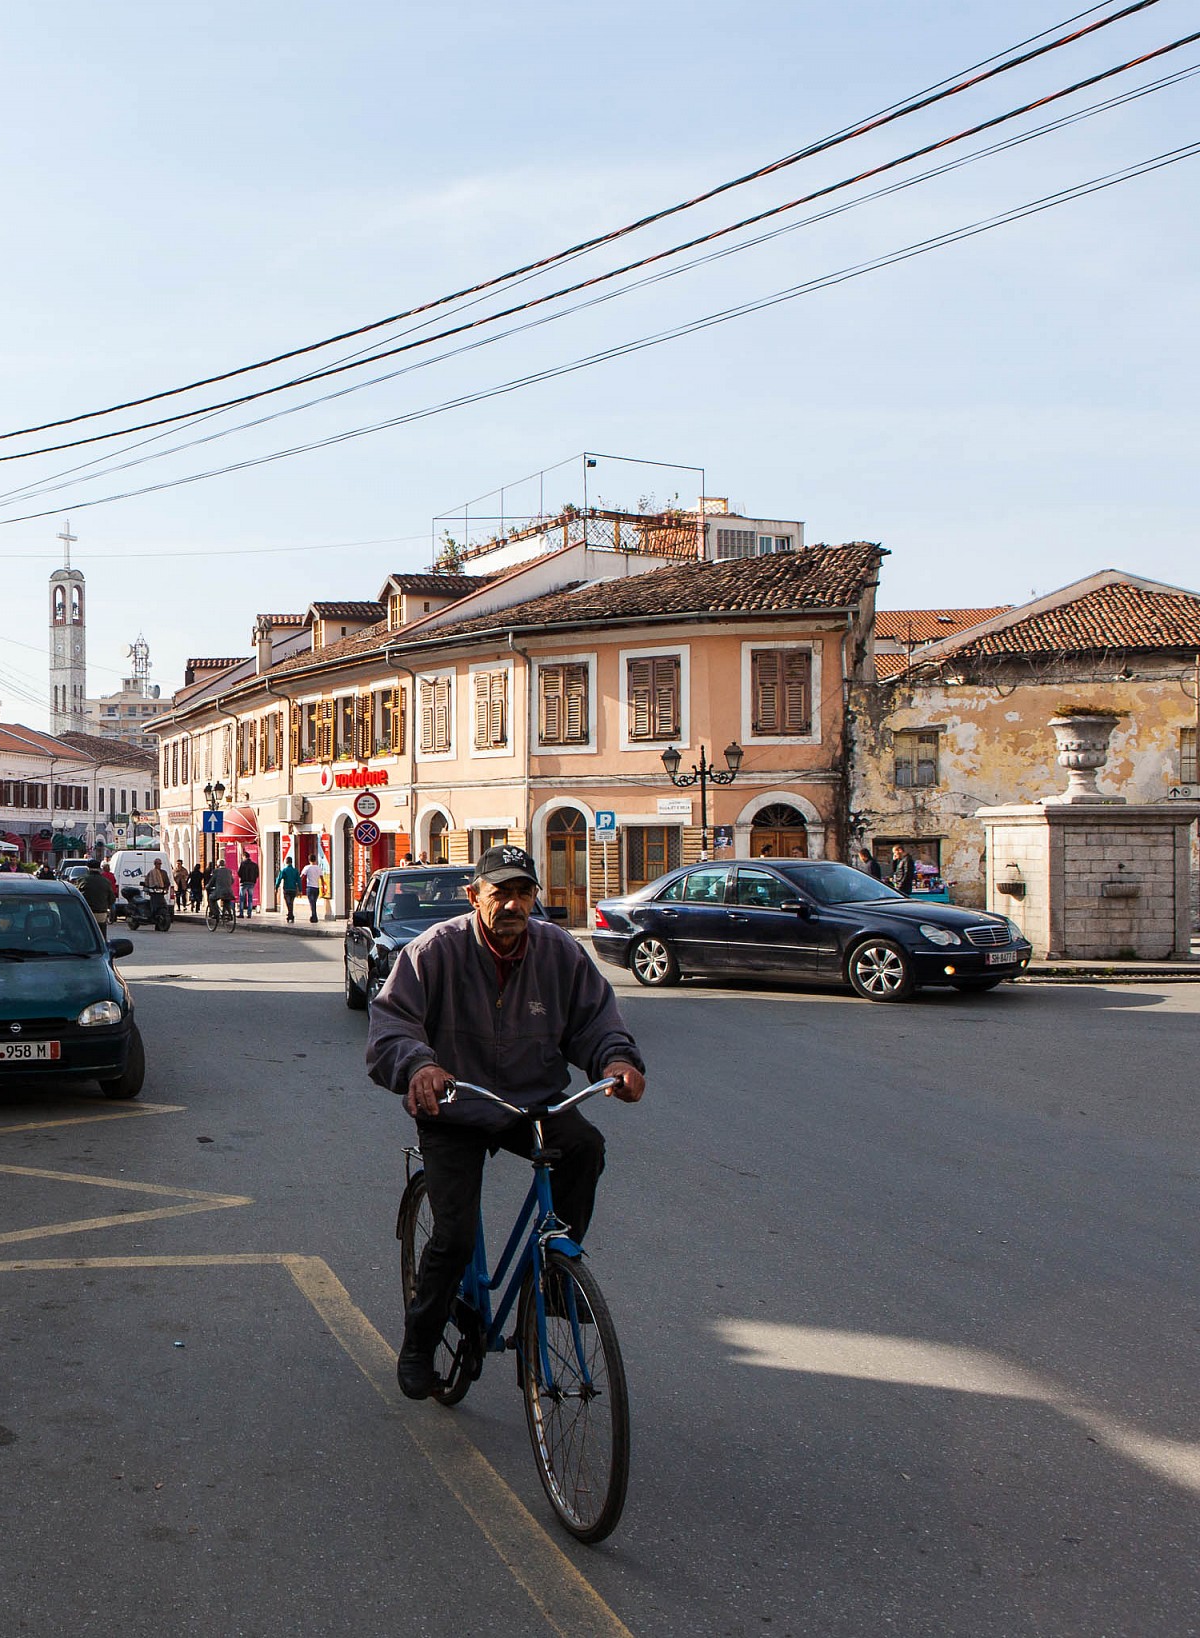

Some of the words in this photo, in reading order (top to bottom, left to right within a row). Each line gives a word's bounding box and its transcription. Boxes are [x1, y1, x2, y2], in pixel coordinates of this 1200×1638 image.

[335, 767, 388, 788] vodafone
[6, 1044, 32, 1059] 958
[36, 1044, 46, 1058] M
